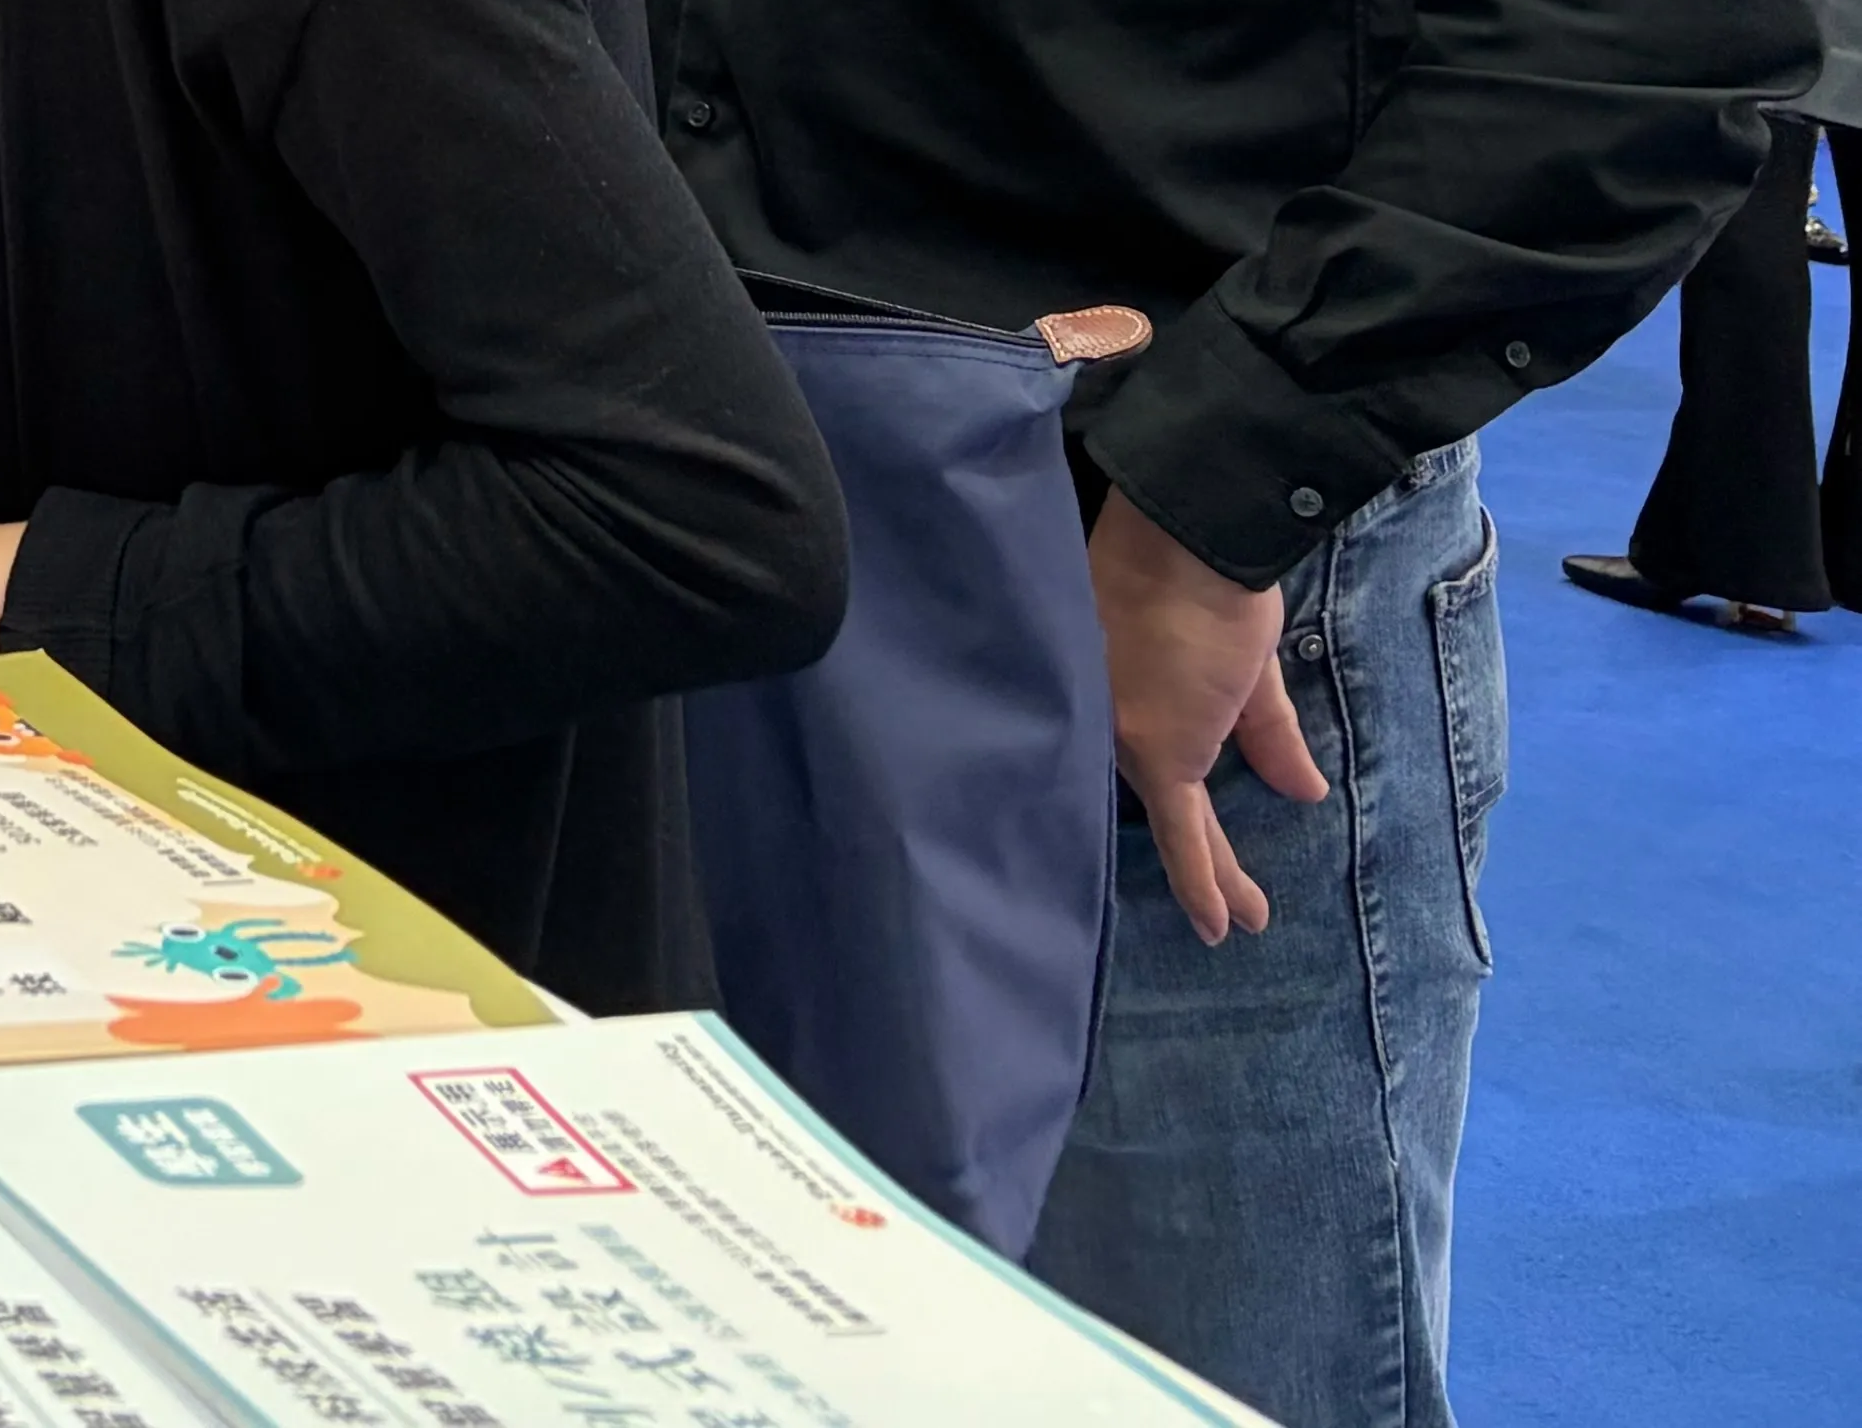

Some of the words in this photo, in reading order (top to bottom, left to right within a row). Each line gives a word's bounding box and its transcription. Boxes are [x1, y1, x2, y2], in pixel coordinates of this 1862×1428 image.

[115, 1109, 220, 1180] 學生
[435, 1080, 536, 1154] 展示用
[176, 1286, 386, 1428] 科技生活
